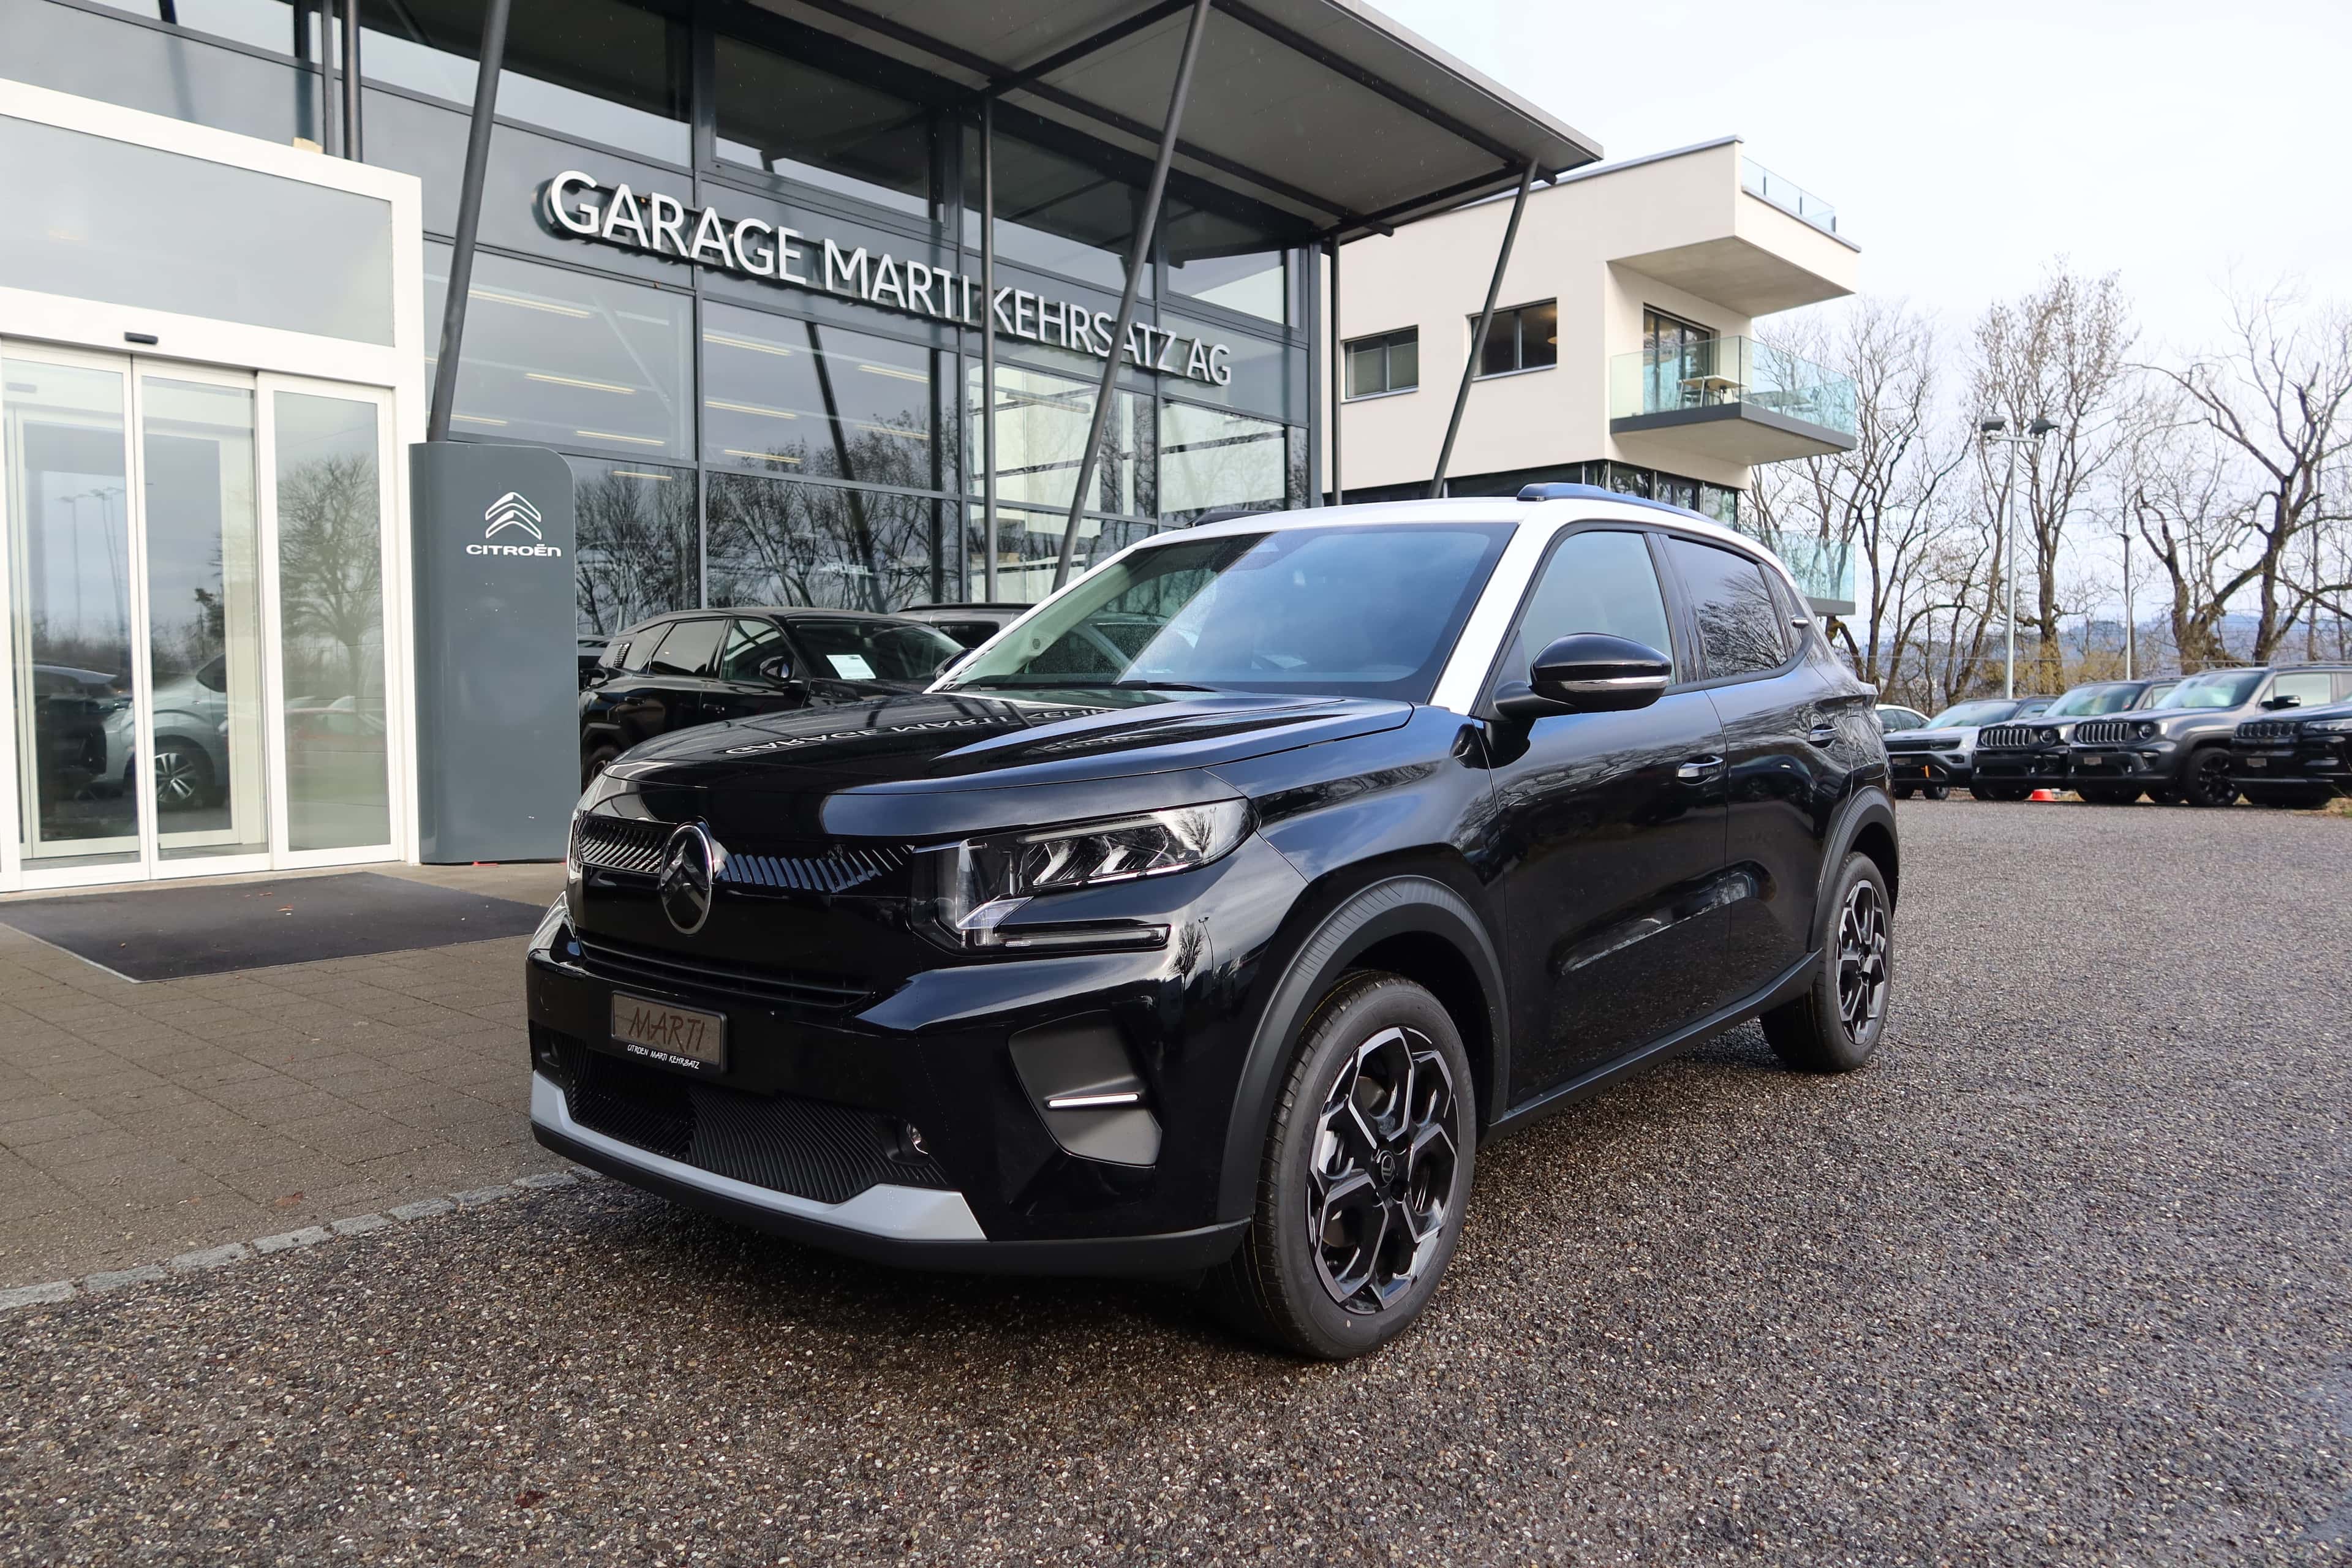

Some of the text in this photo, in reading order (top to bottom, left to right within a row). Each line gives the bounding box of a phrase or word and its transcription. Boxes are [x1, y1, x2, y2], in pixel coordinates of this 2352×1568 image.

[550, 170, 807, 285] GARAGE
[824, 238, 970, 323] MARTI
[1186, 337, 1231, 386] AG
[628, 1007, 705, 1054] MARTI
[649, 1050, 667, 1061] MARTI
[668, 1055, 700, 1069] KEHRSATZ
